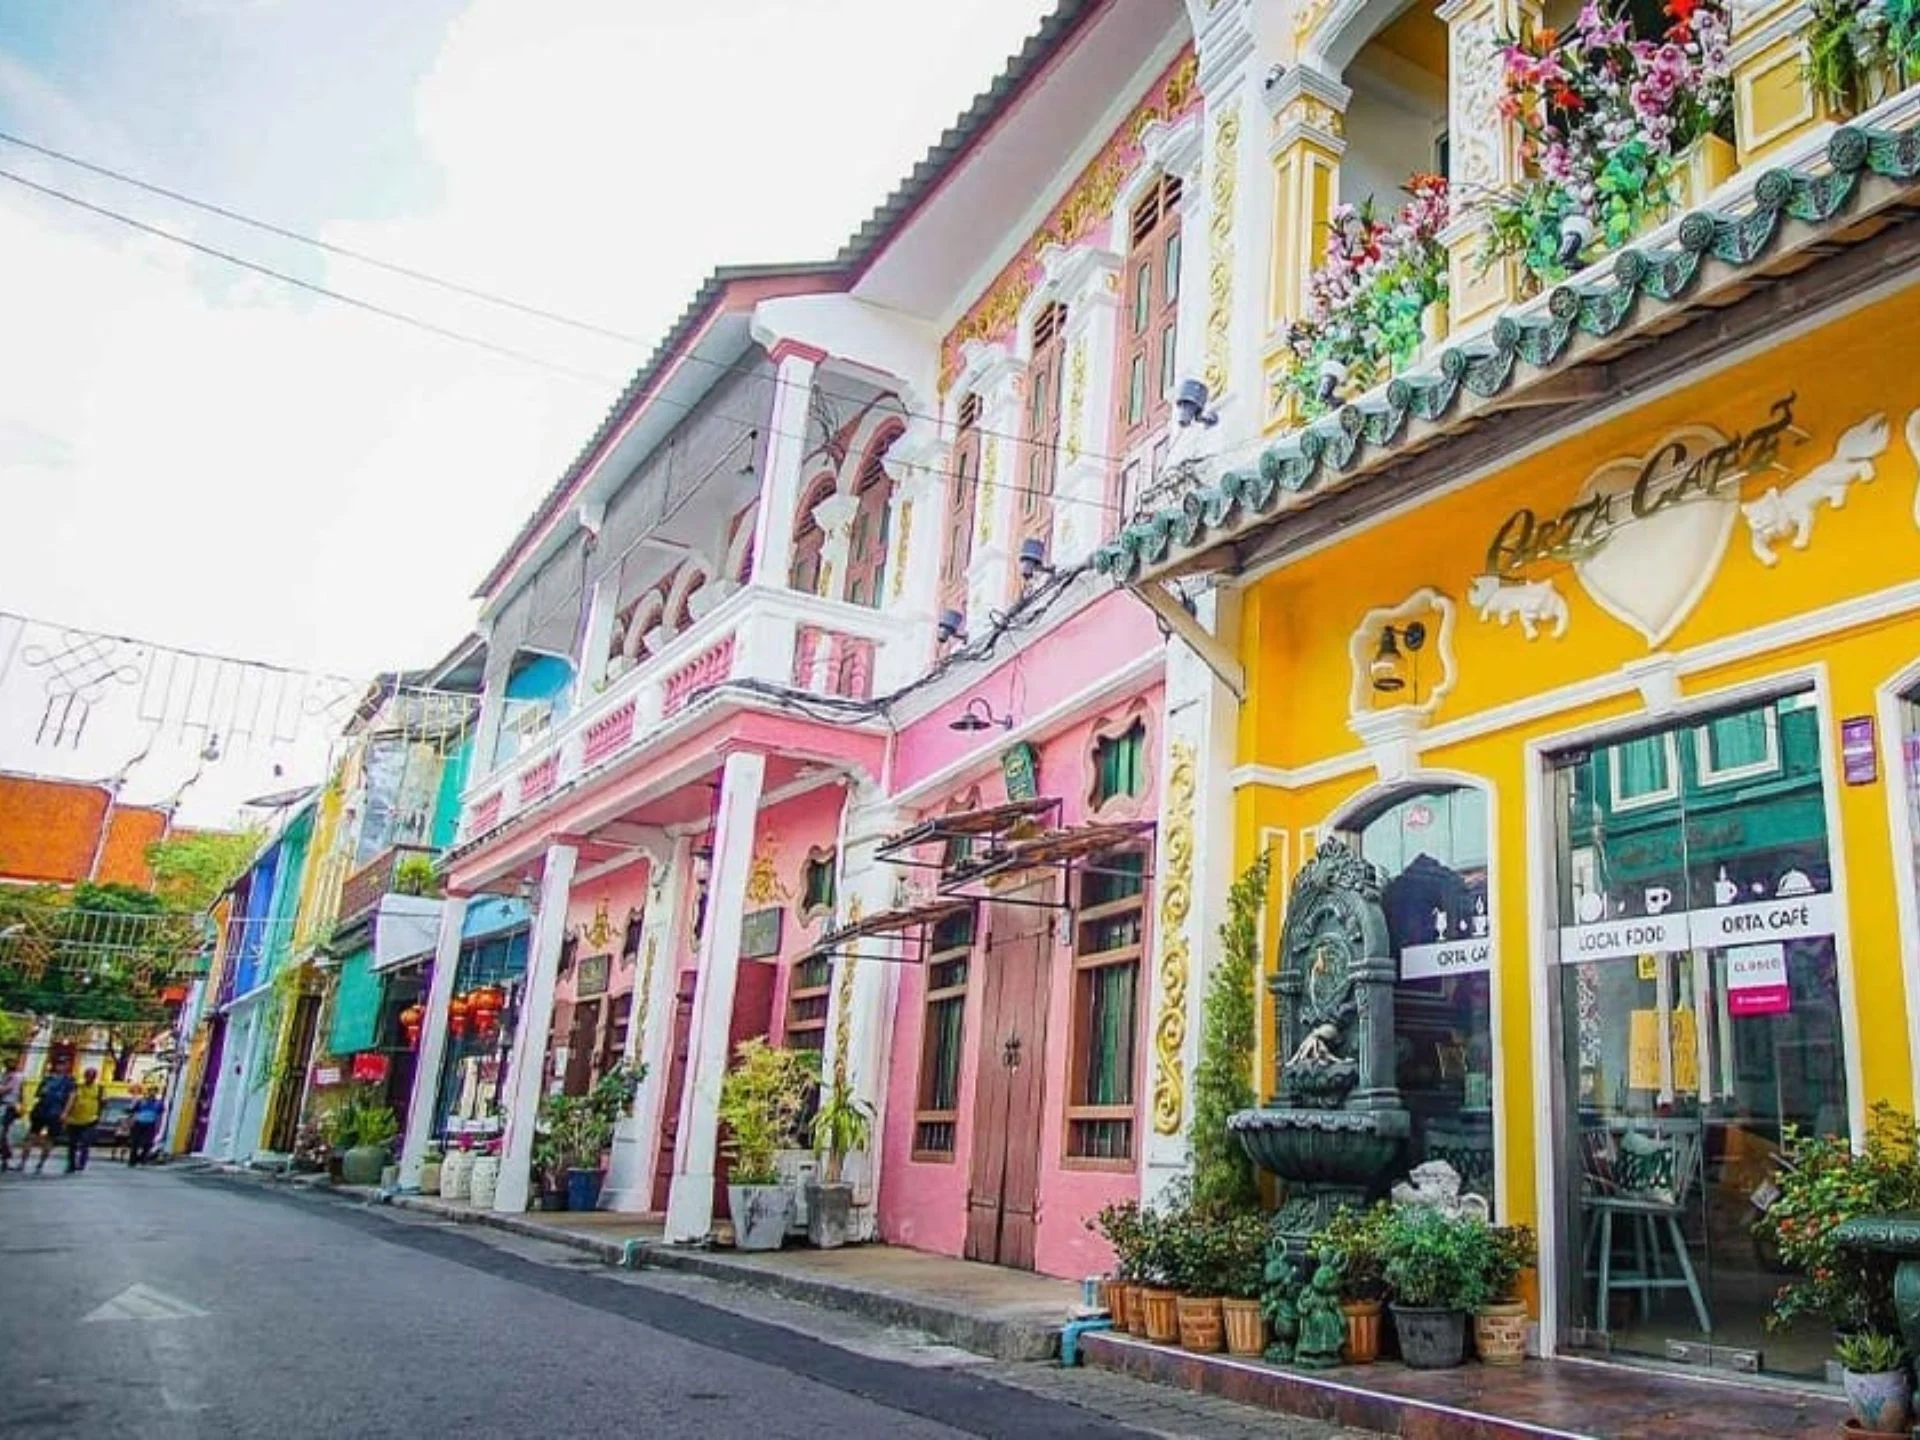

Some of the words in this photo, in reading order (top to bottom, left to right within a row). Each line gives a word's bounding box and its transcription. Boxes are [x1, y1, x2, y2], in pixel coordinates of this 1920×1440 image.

[1722, 914, 1764, 933] ORTA
[1769, 903, 1809, 929] CAFÉ
[1580, 931, 1621, 951] LOCAL
[1626, 925, 1666, 946] FOOD
[1437, 949, 1468, 966] ORTA
